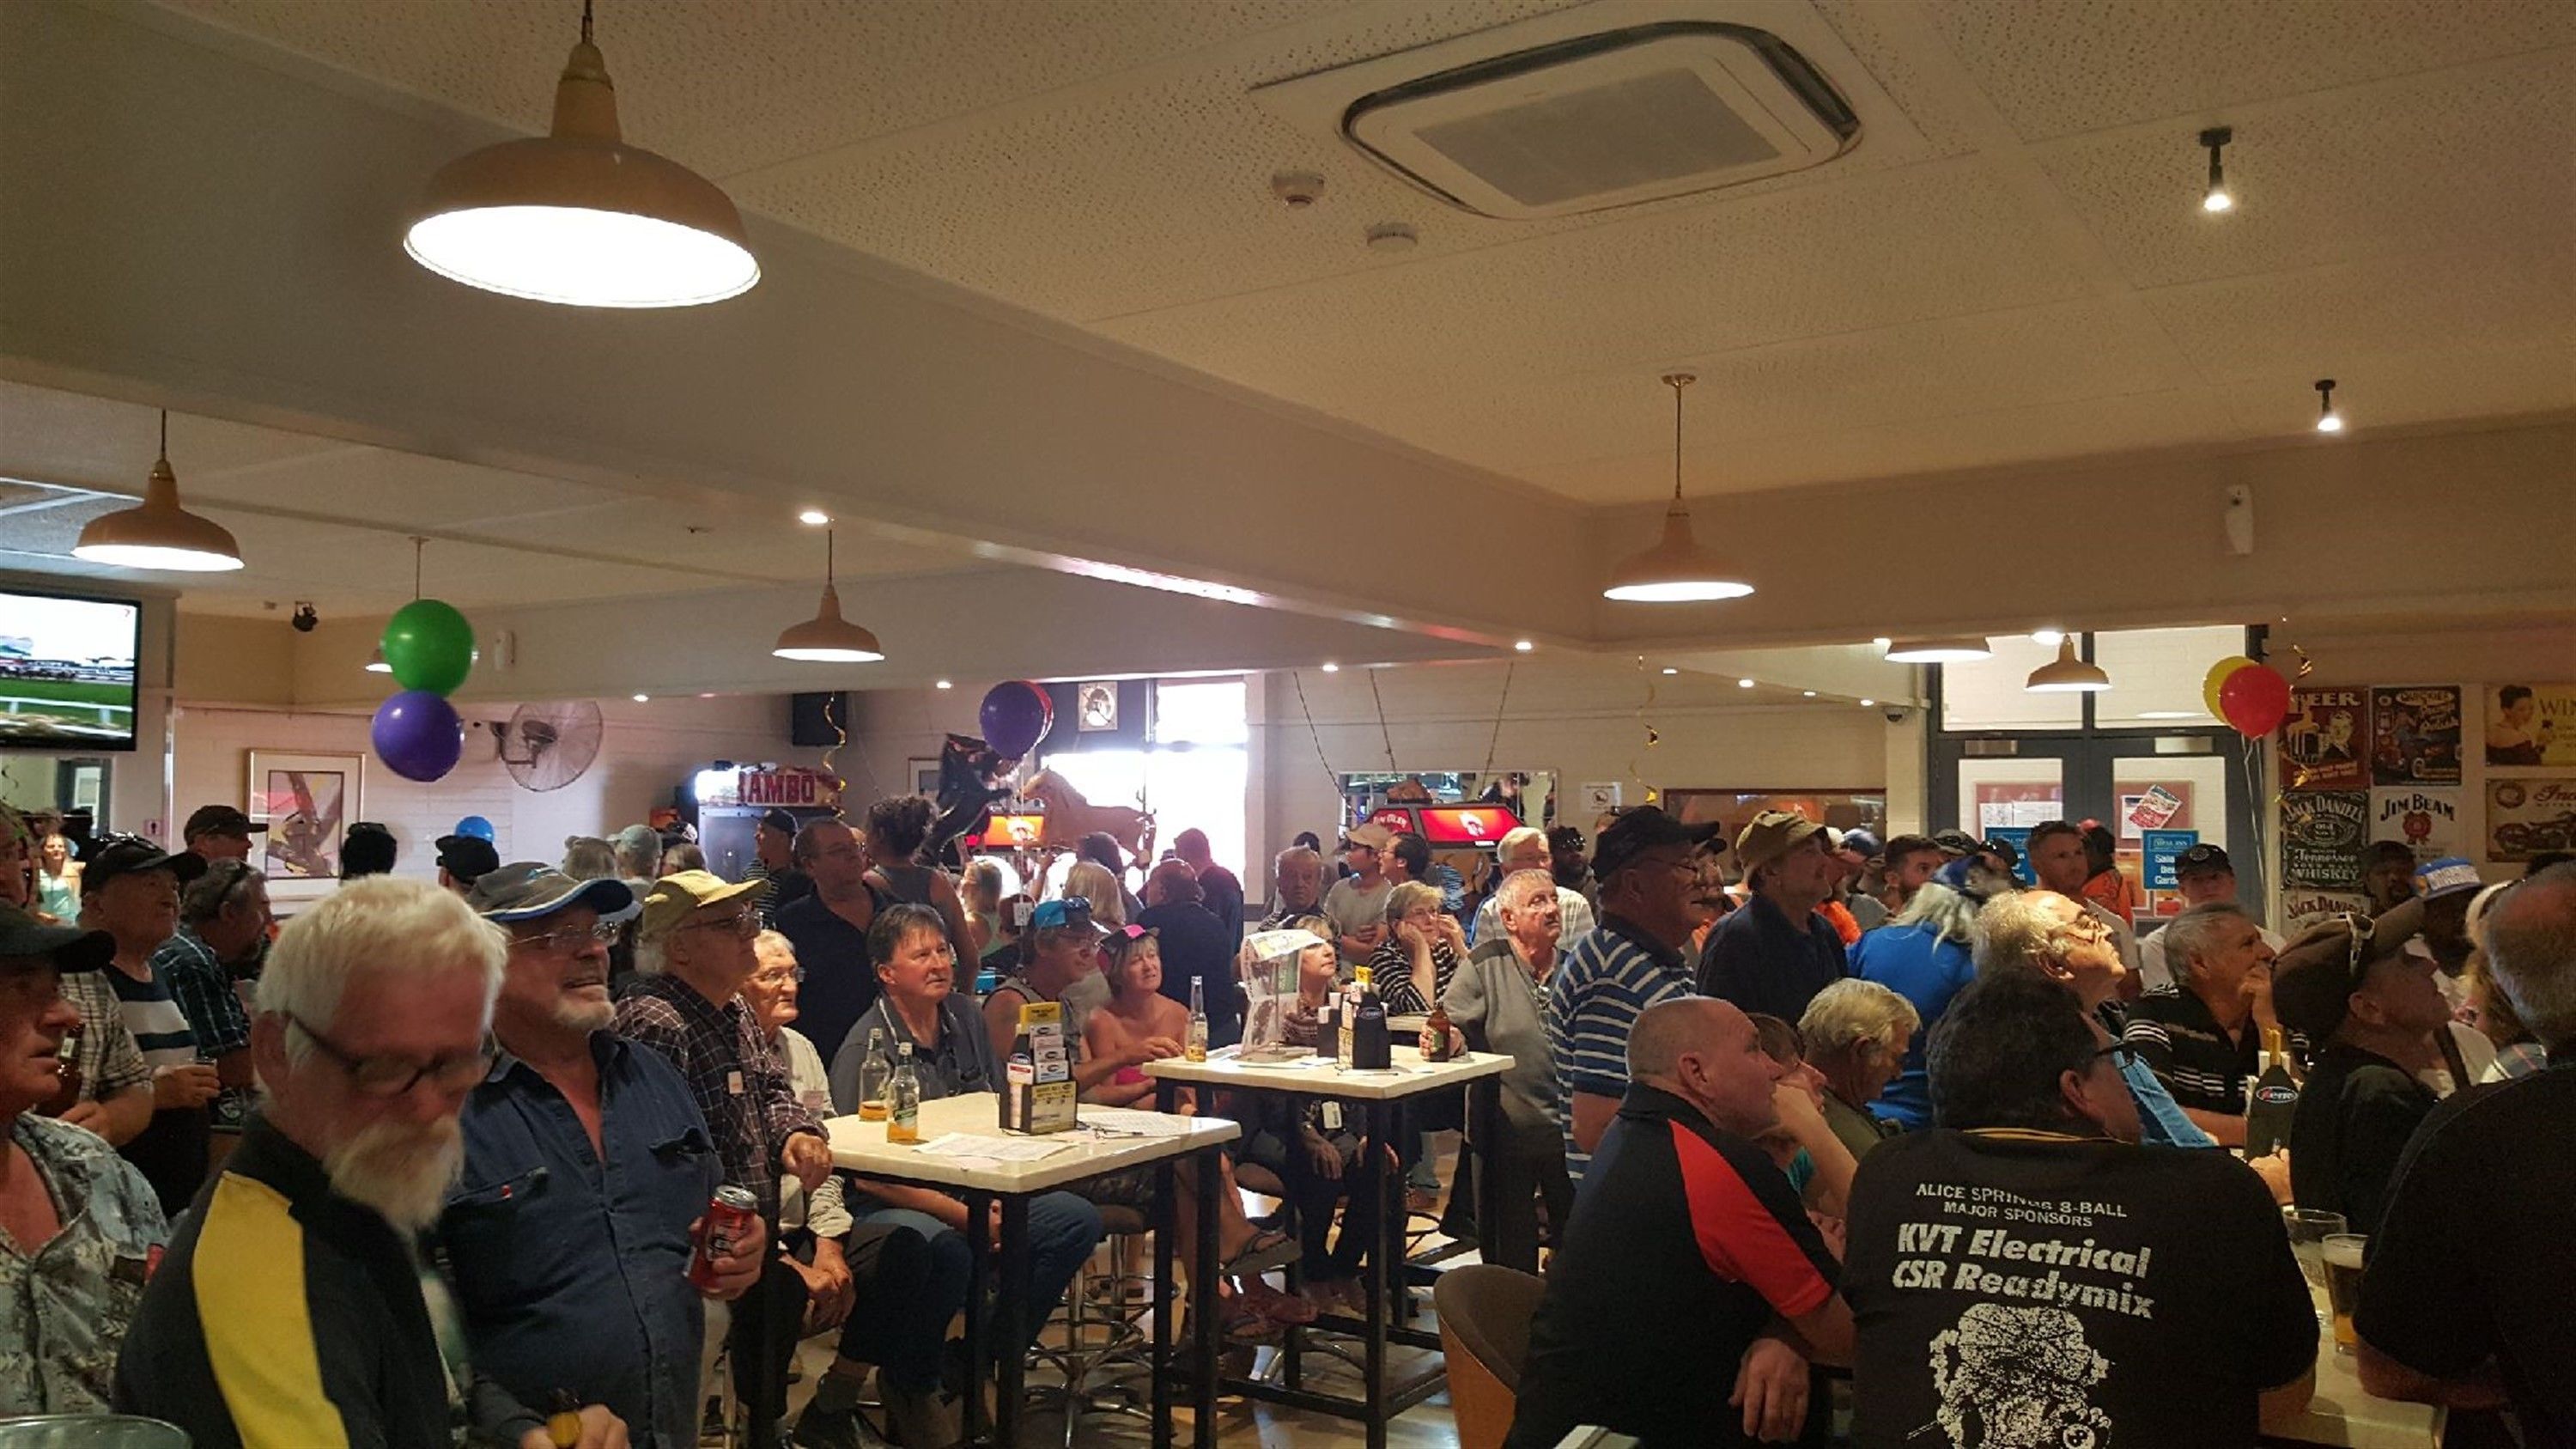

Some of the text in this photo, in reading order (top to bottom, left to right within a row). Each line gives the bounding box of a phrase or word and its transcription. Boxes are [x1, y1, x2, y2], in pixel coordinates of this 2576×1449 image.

[2286, 800, 2316, 822] JACK
[2380, 794, 2455, 821] JIM BEAM
[2291, 868, 2360, 880] WHISKEY
[1916, 1183, 2128, 1218] ALICE SPRINGS 8-BALL
[1943, 1202, 2093, 1227] MAJOR SPONSORS
[1897, 1222, 2152, 1278] KVT Electrical
[1892, 1259, 2156, 1319] CSR Readymix
